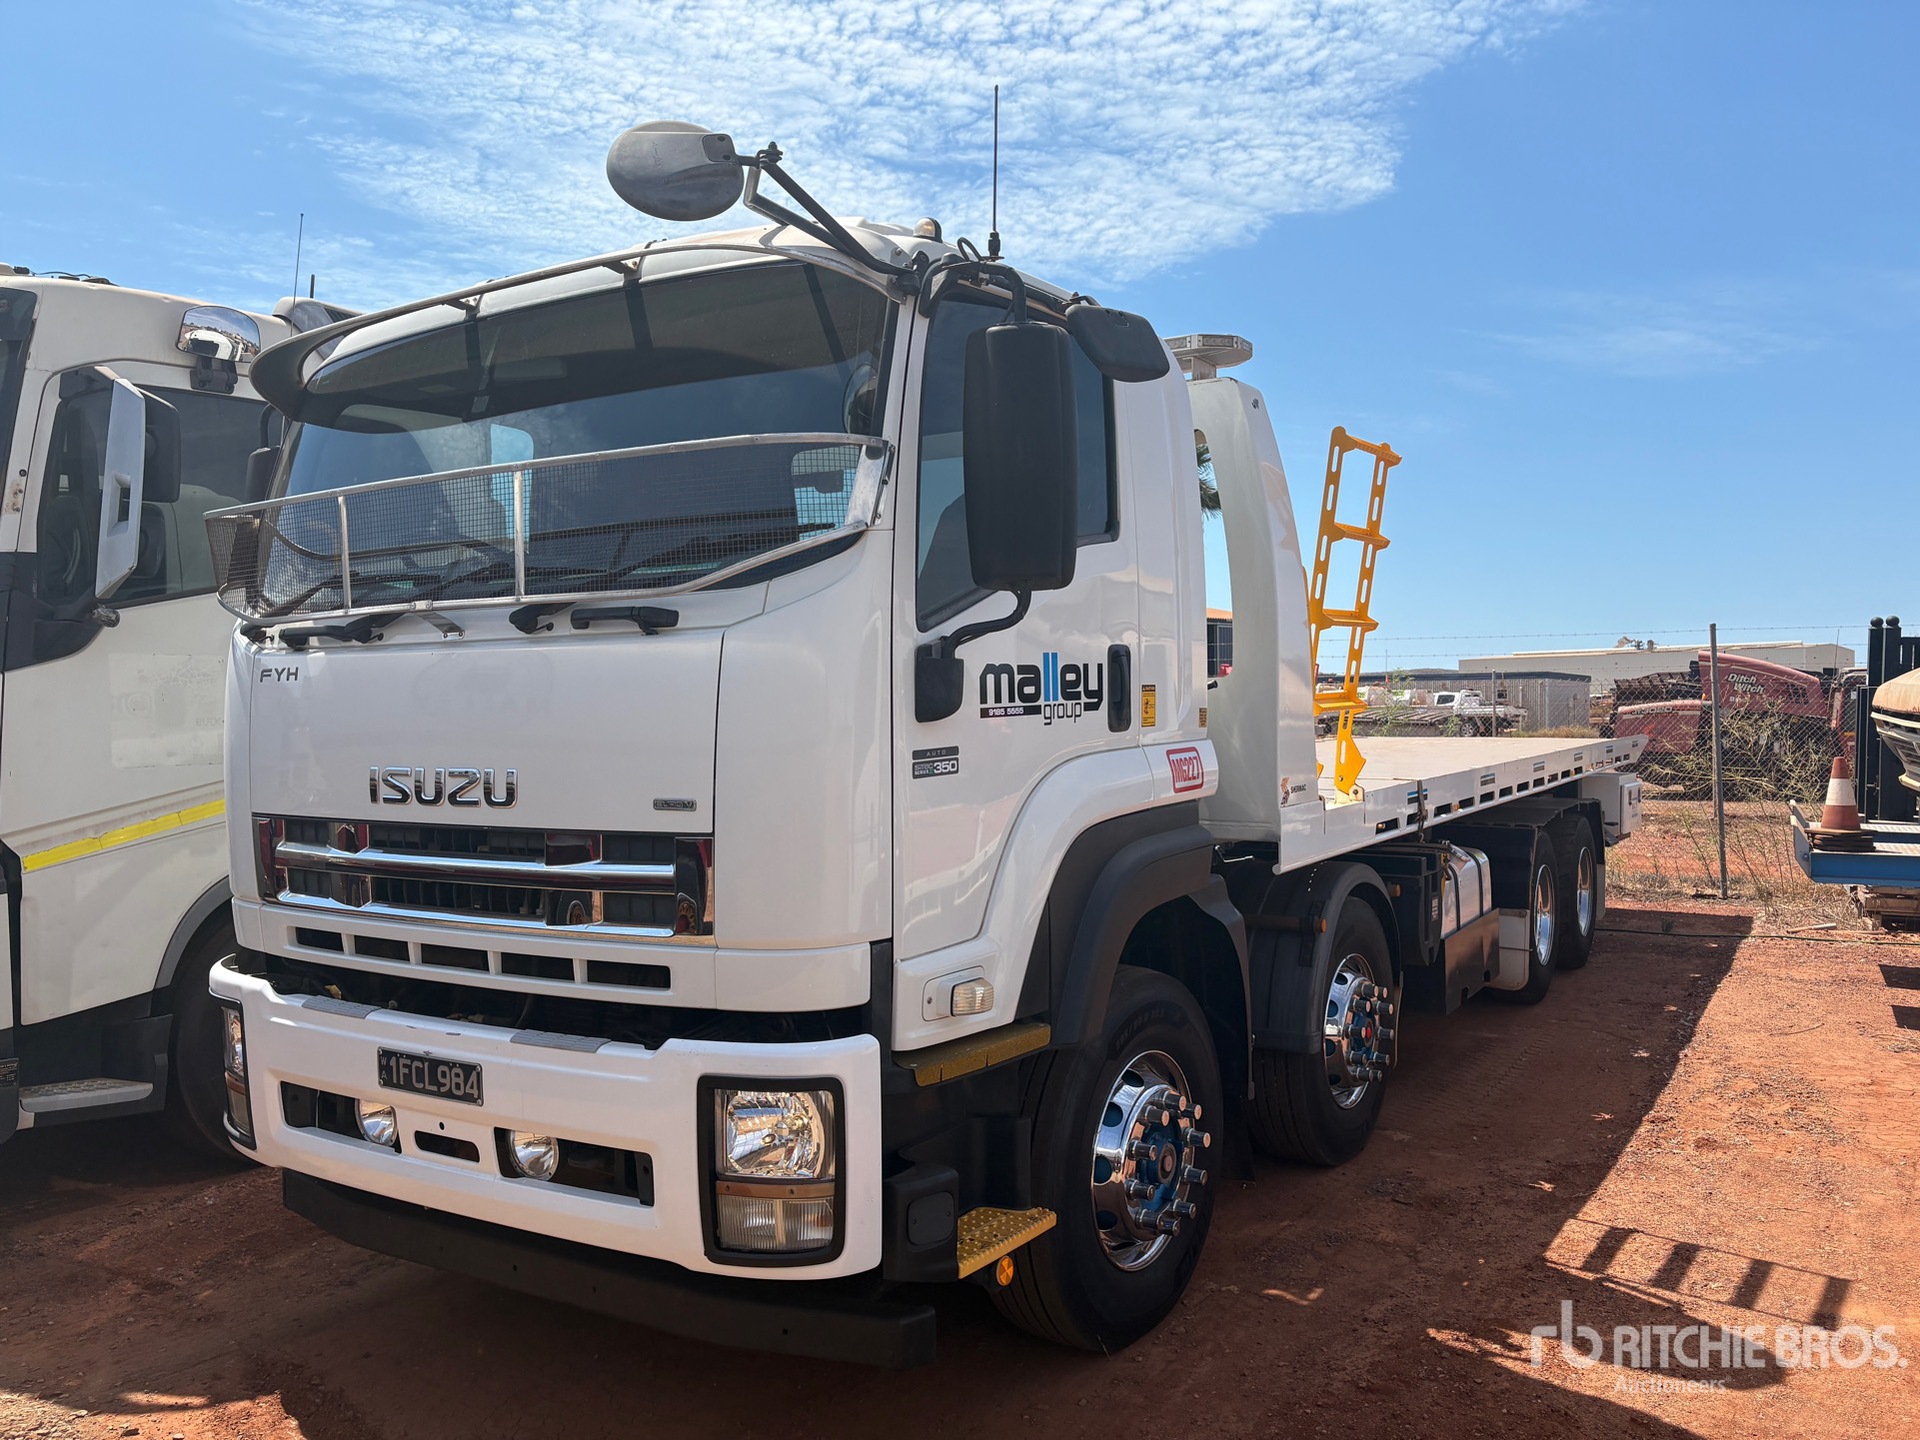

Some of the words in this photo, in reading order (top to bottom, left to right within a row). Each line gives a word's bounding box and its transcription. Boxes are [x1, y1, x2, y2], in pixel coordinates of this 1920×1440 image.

[260, 666, 298, 682] FYH
[980, 652, 1103, 711] malley
[1728, 673, 1757, 684] Ditch
[1734, 682, 1765, 694] Witch
[1006, 707, 1024, 715] 5555
[1043, 702, 1081, 725] group
[926, 749, 947, 757] AUTO
[933, 760, 958, 774] 350
[369, 766, 518, 809] ISUZU
[389, 1056, 479, 1098] 1FCL984
